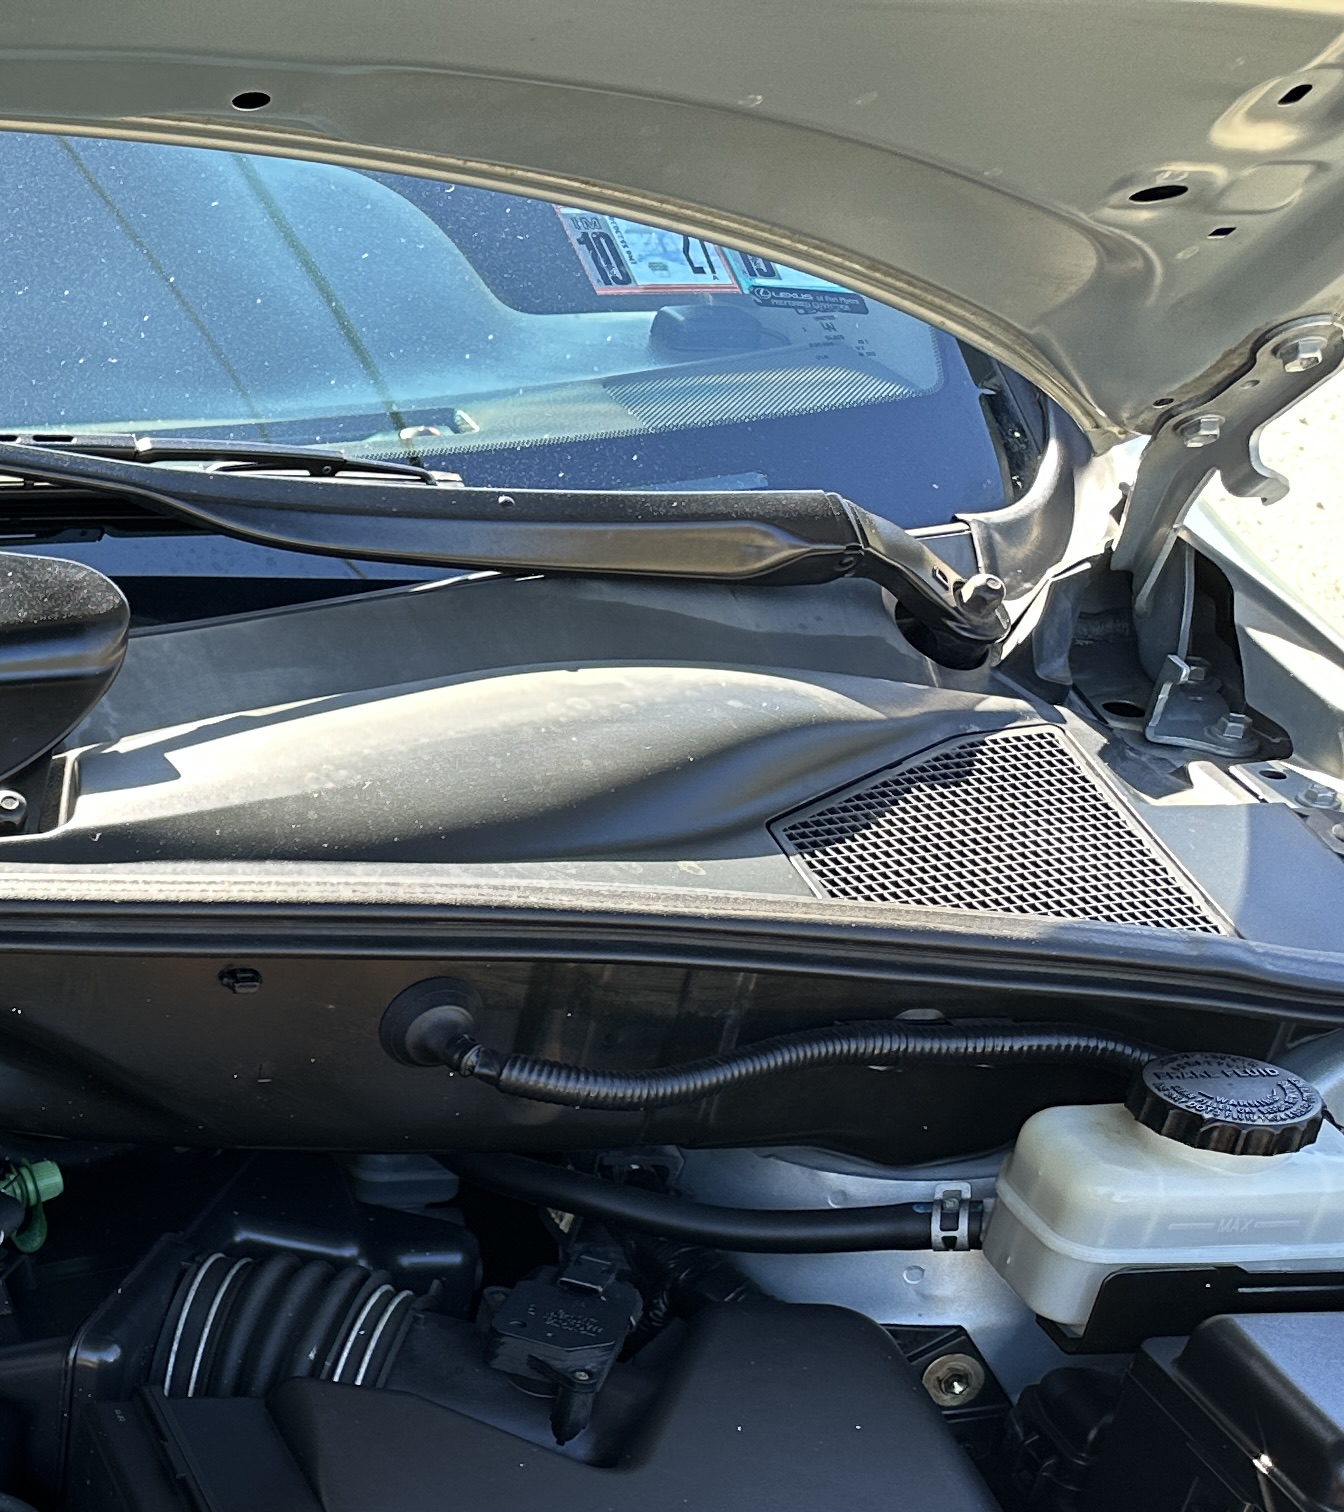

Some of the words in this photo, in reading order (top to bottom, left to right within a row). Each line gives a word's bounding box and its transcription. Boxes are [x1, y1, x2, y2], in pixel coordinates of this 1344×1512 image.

[576, 231, 633, 286] 10
[772, 291, 813, 300] LEXUS
[1222, 1068, 1280, 1078] FLUID
[1217, 1218, 1254, 1233] MAX
